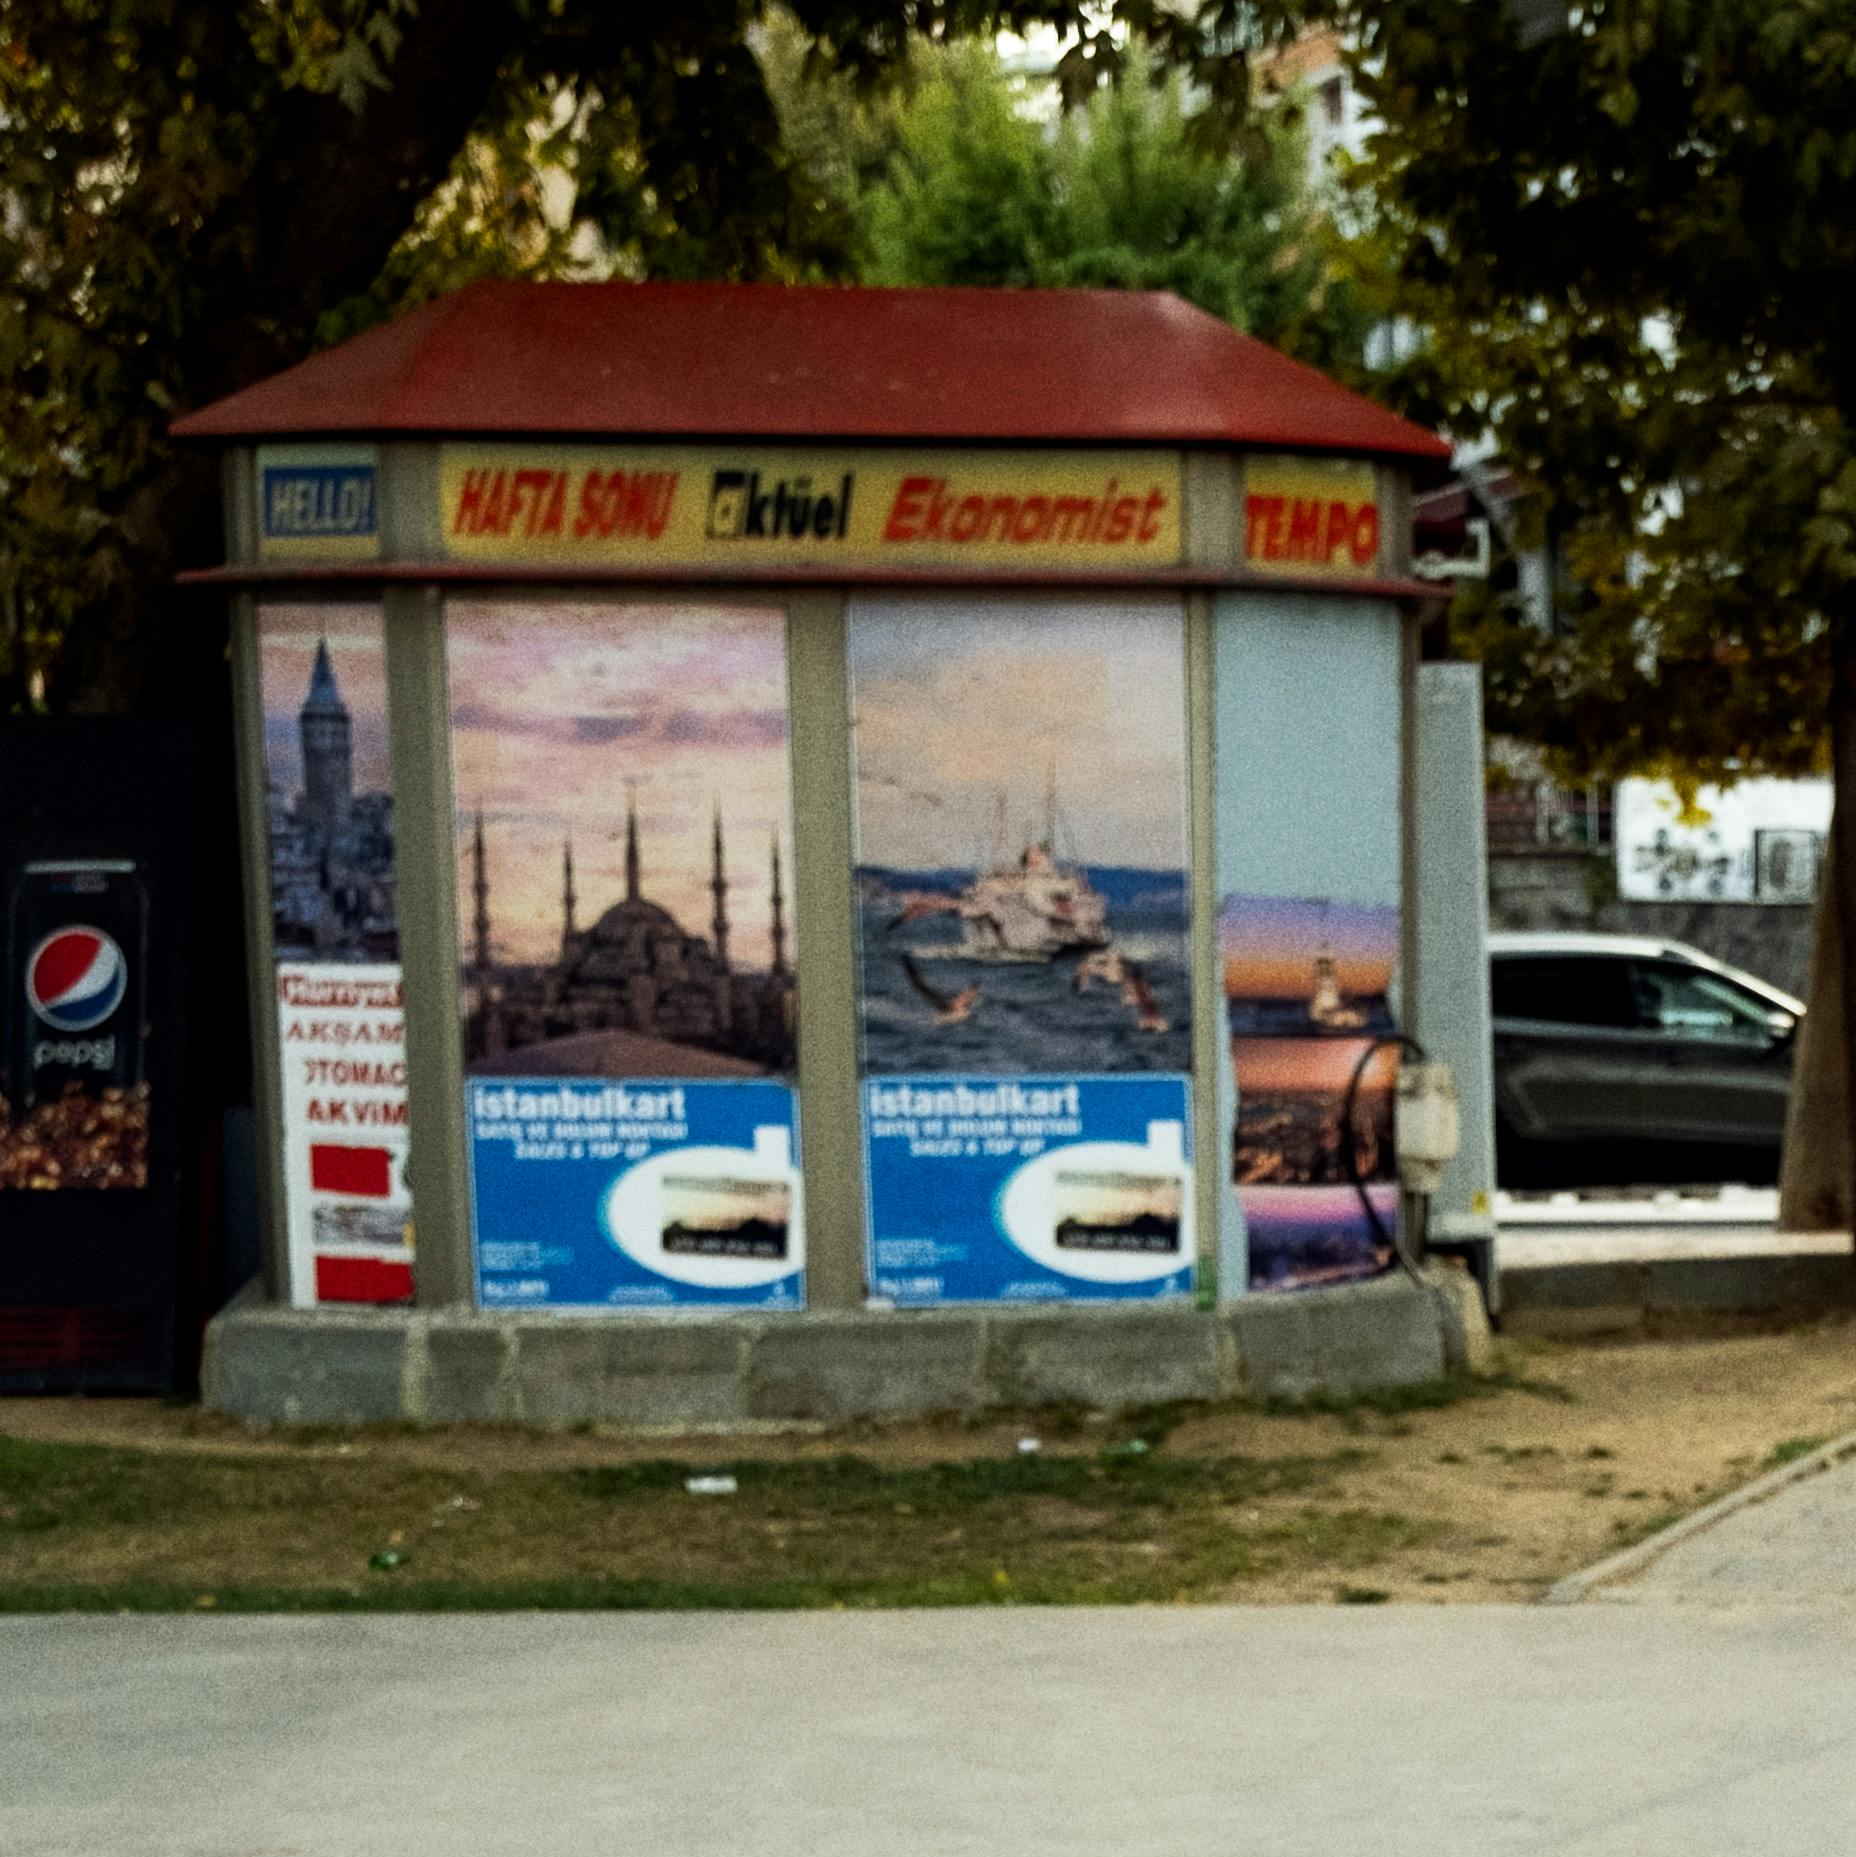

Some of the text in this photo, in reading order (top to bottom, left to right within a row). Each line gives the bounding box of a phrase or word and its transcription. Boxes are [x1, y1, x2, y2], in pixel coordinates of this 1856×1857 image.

[268, 477, 373, 531] HELLO!
[454, 468, 680, 540] HAFTA SONU
[884, 475, 1169, 544] Ekonomist
[1246, 495, 1380, 567] TEMPO
[33, 1034, 116, 1071] pepsi
[474, 1086, 686, 1121] istanbulkart
[869, 1084, 1079, 1118] istanbulkart
